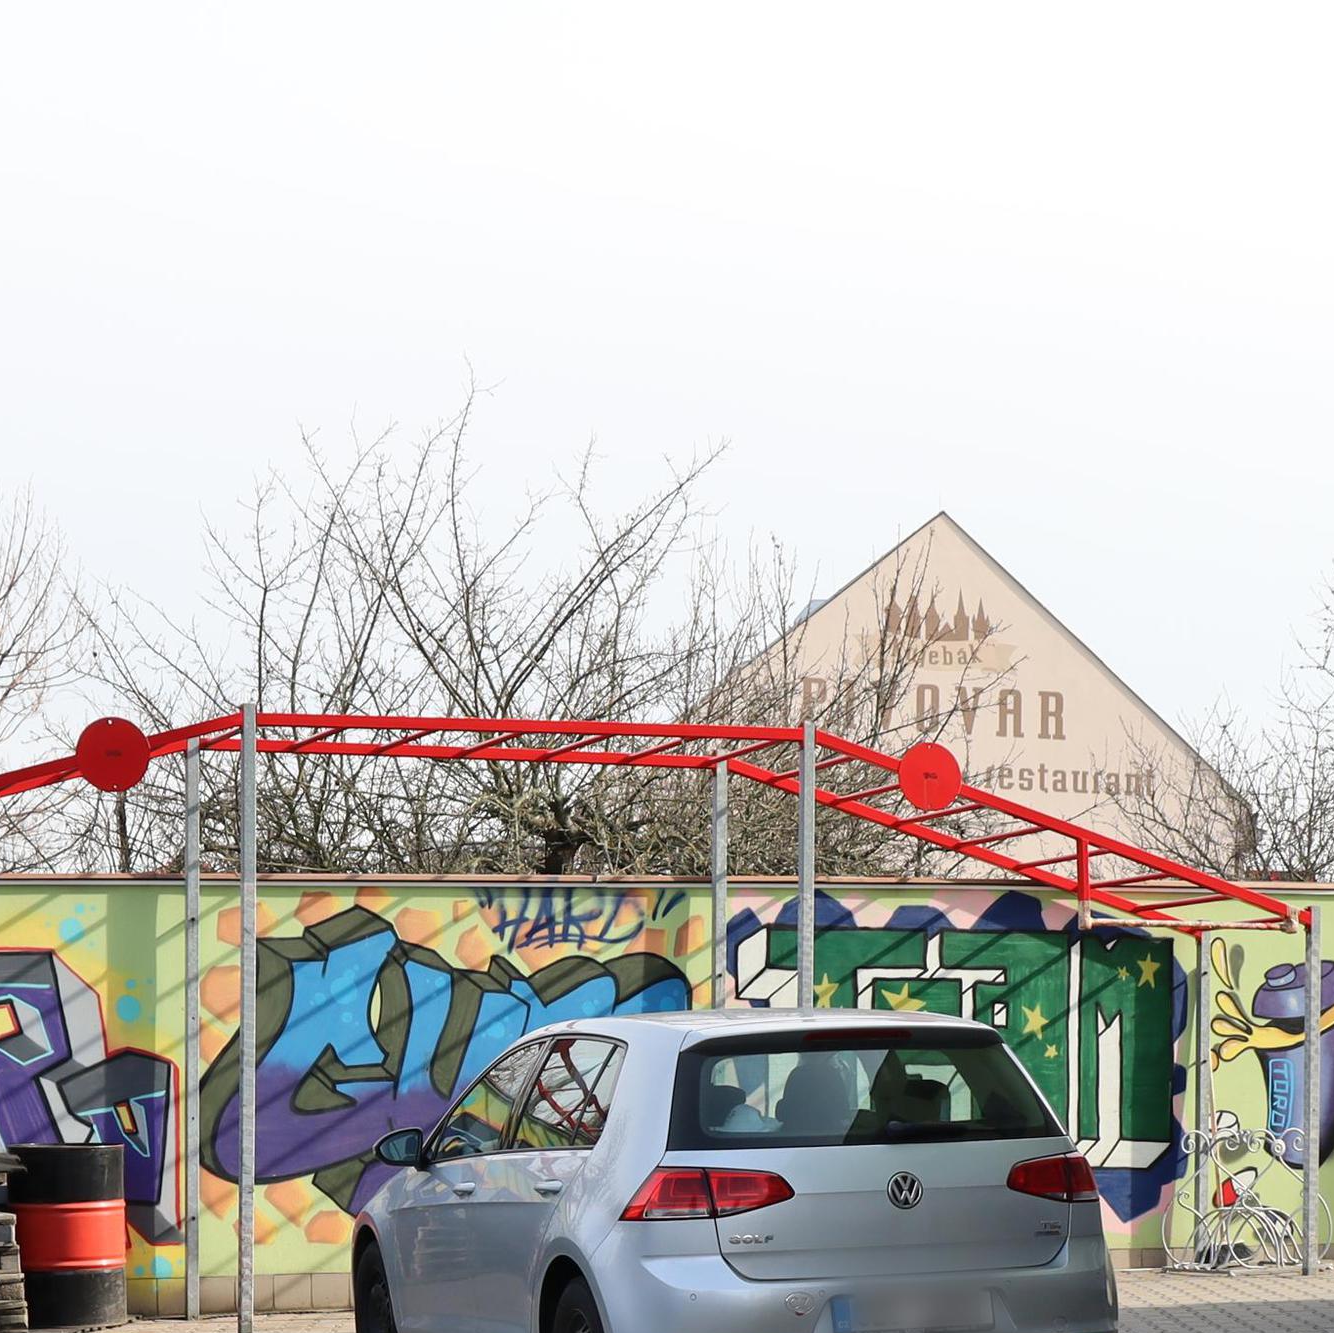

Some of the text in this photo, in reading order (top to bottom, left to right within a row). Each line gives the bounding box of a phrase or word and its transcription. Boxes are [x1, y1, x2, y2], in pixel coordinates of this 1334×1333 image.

[985, 763, 1155, 797] restaurant
[1271, 1062, 1289, 1128] TORO
[728, 1234, 774, 1245] GOLF
